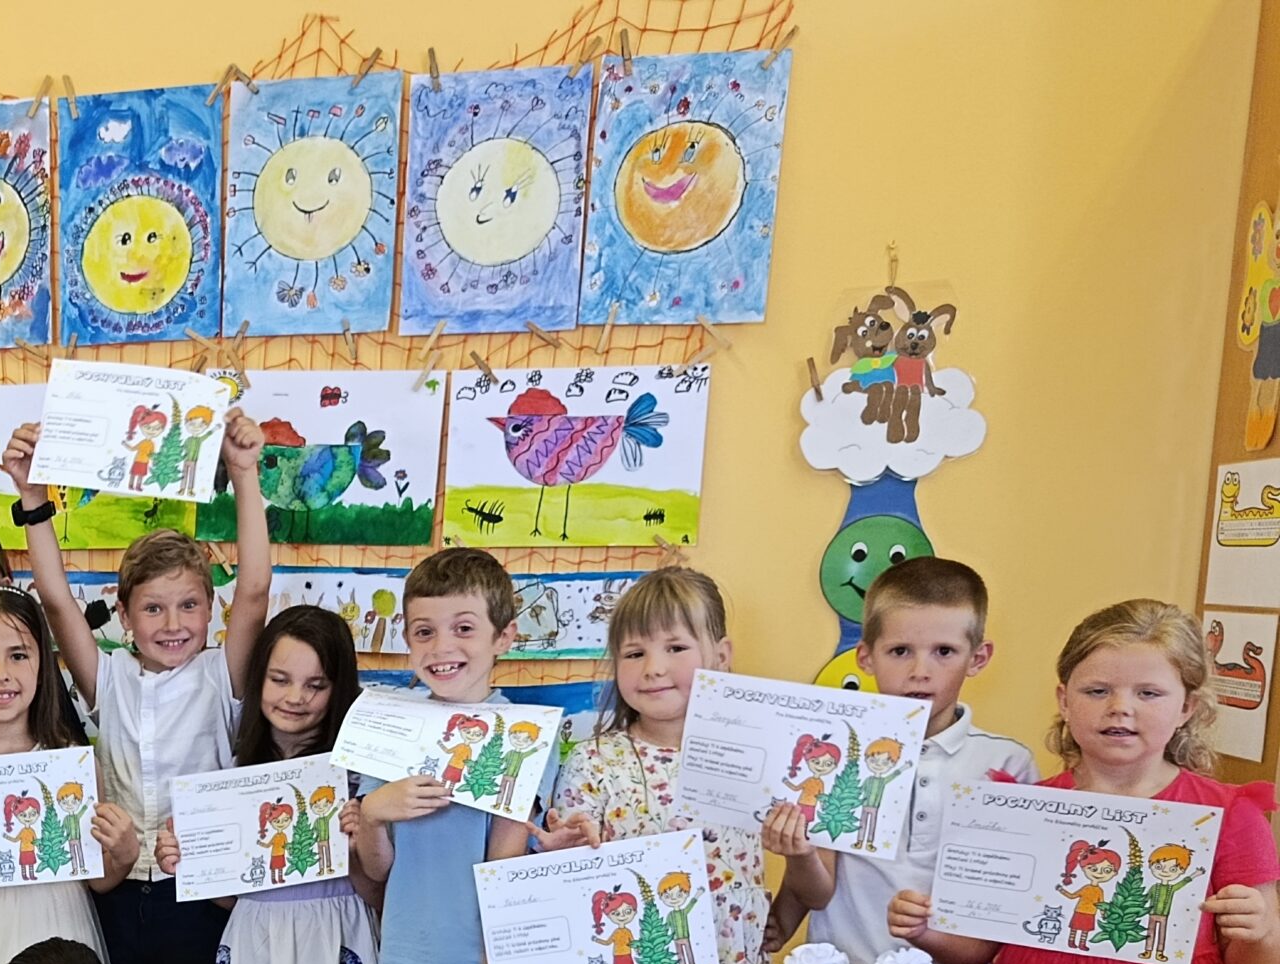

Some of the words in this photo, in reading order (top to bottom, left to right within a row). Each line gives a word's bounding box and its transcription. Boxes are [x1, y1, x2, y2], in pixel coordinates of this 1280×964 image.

[723, 686, 823, 712] POCHVALNÝ
[826, 700, 868, 718] LIST
[19, 762, 48, 774] LIST
[982, 793, 1098, 819] POCHVALNÝ
[1102, 808, 1148, 824] LIST
[507, 856, 604, 883] POCHVALNÝ
[608, 850, 646, 866] LIST
